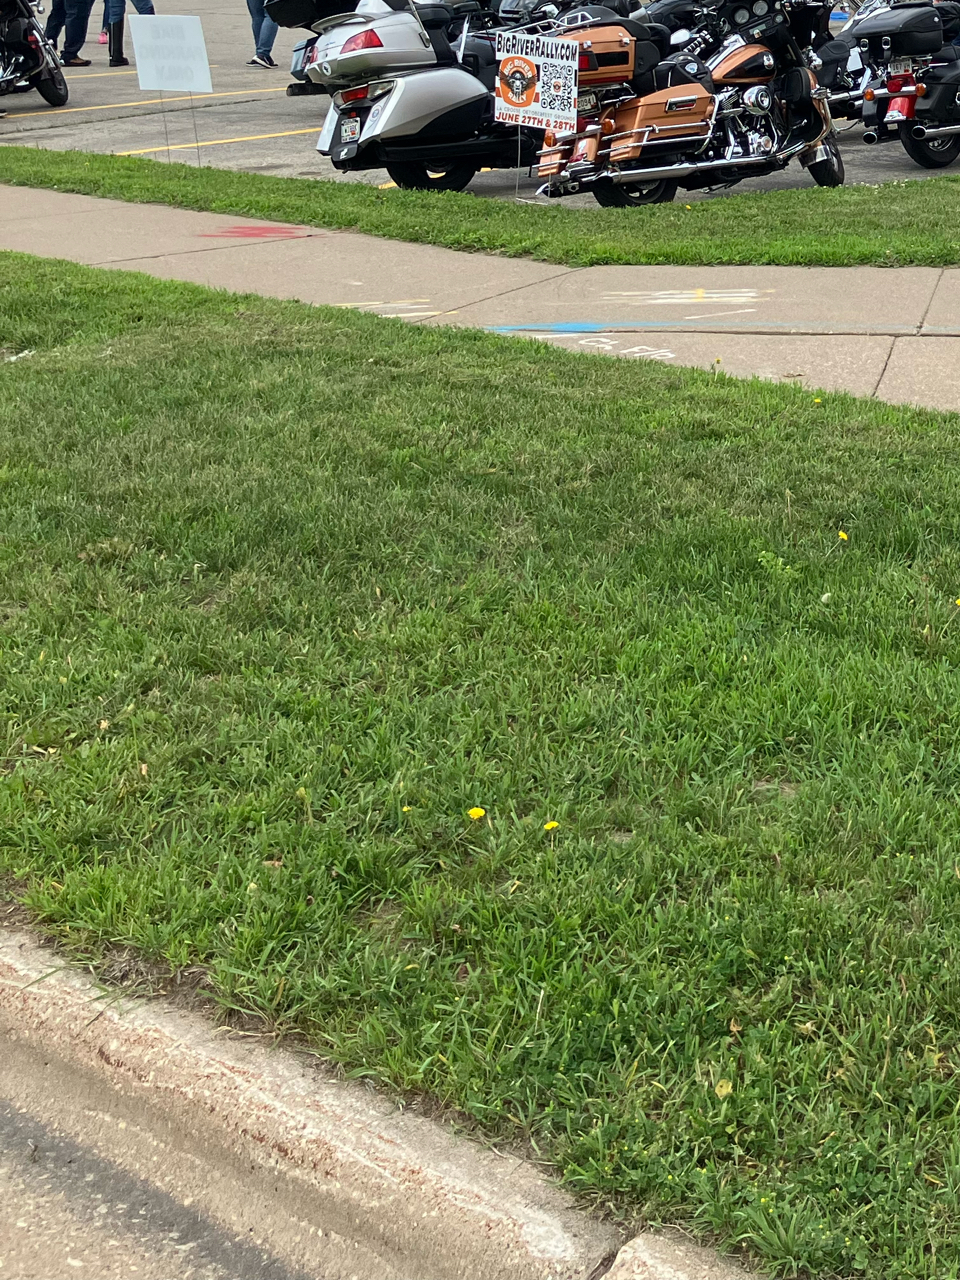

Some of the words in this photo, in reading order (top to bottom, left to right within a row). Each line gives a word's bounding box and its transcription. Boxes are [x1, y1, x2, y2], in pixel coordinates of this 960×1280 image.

[503, 61, 514, 76] BIG
[514, 59, 533, 78] RIVER
[507, 91, 527, 104] RALLY
[495, 112, 520, 123] JUNE
[521, 115, 544, 127] 27TH
[545, 119, 551, 128] &
[552, 120, 576, 131] 28TH
